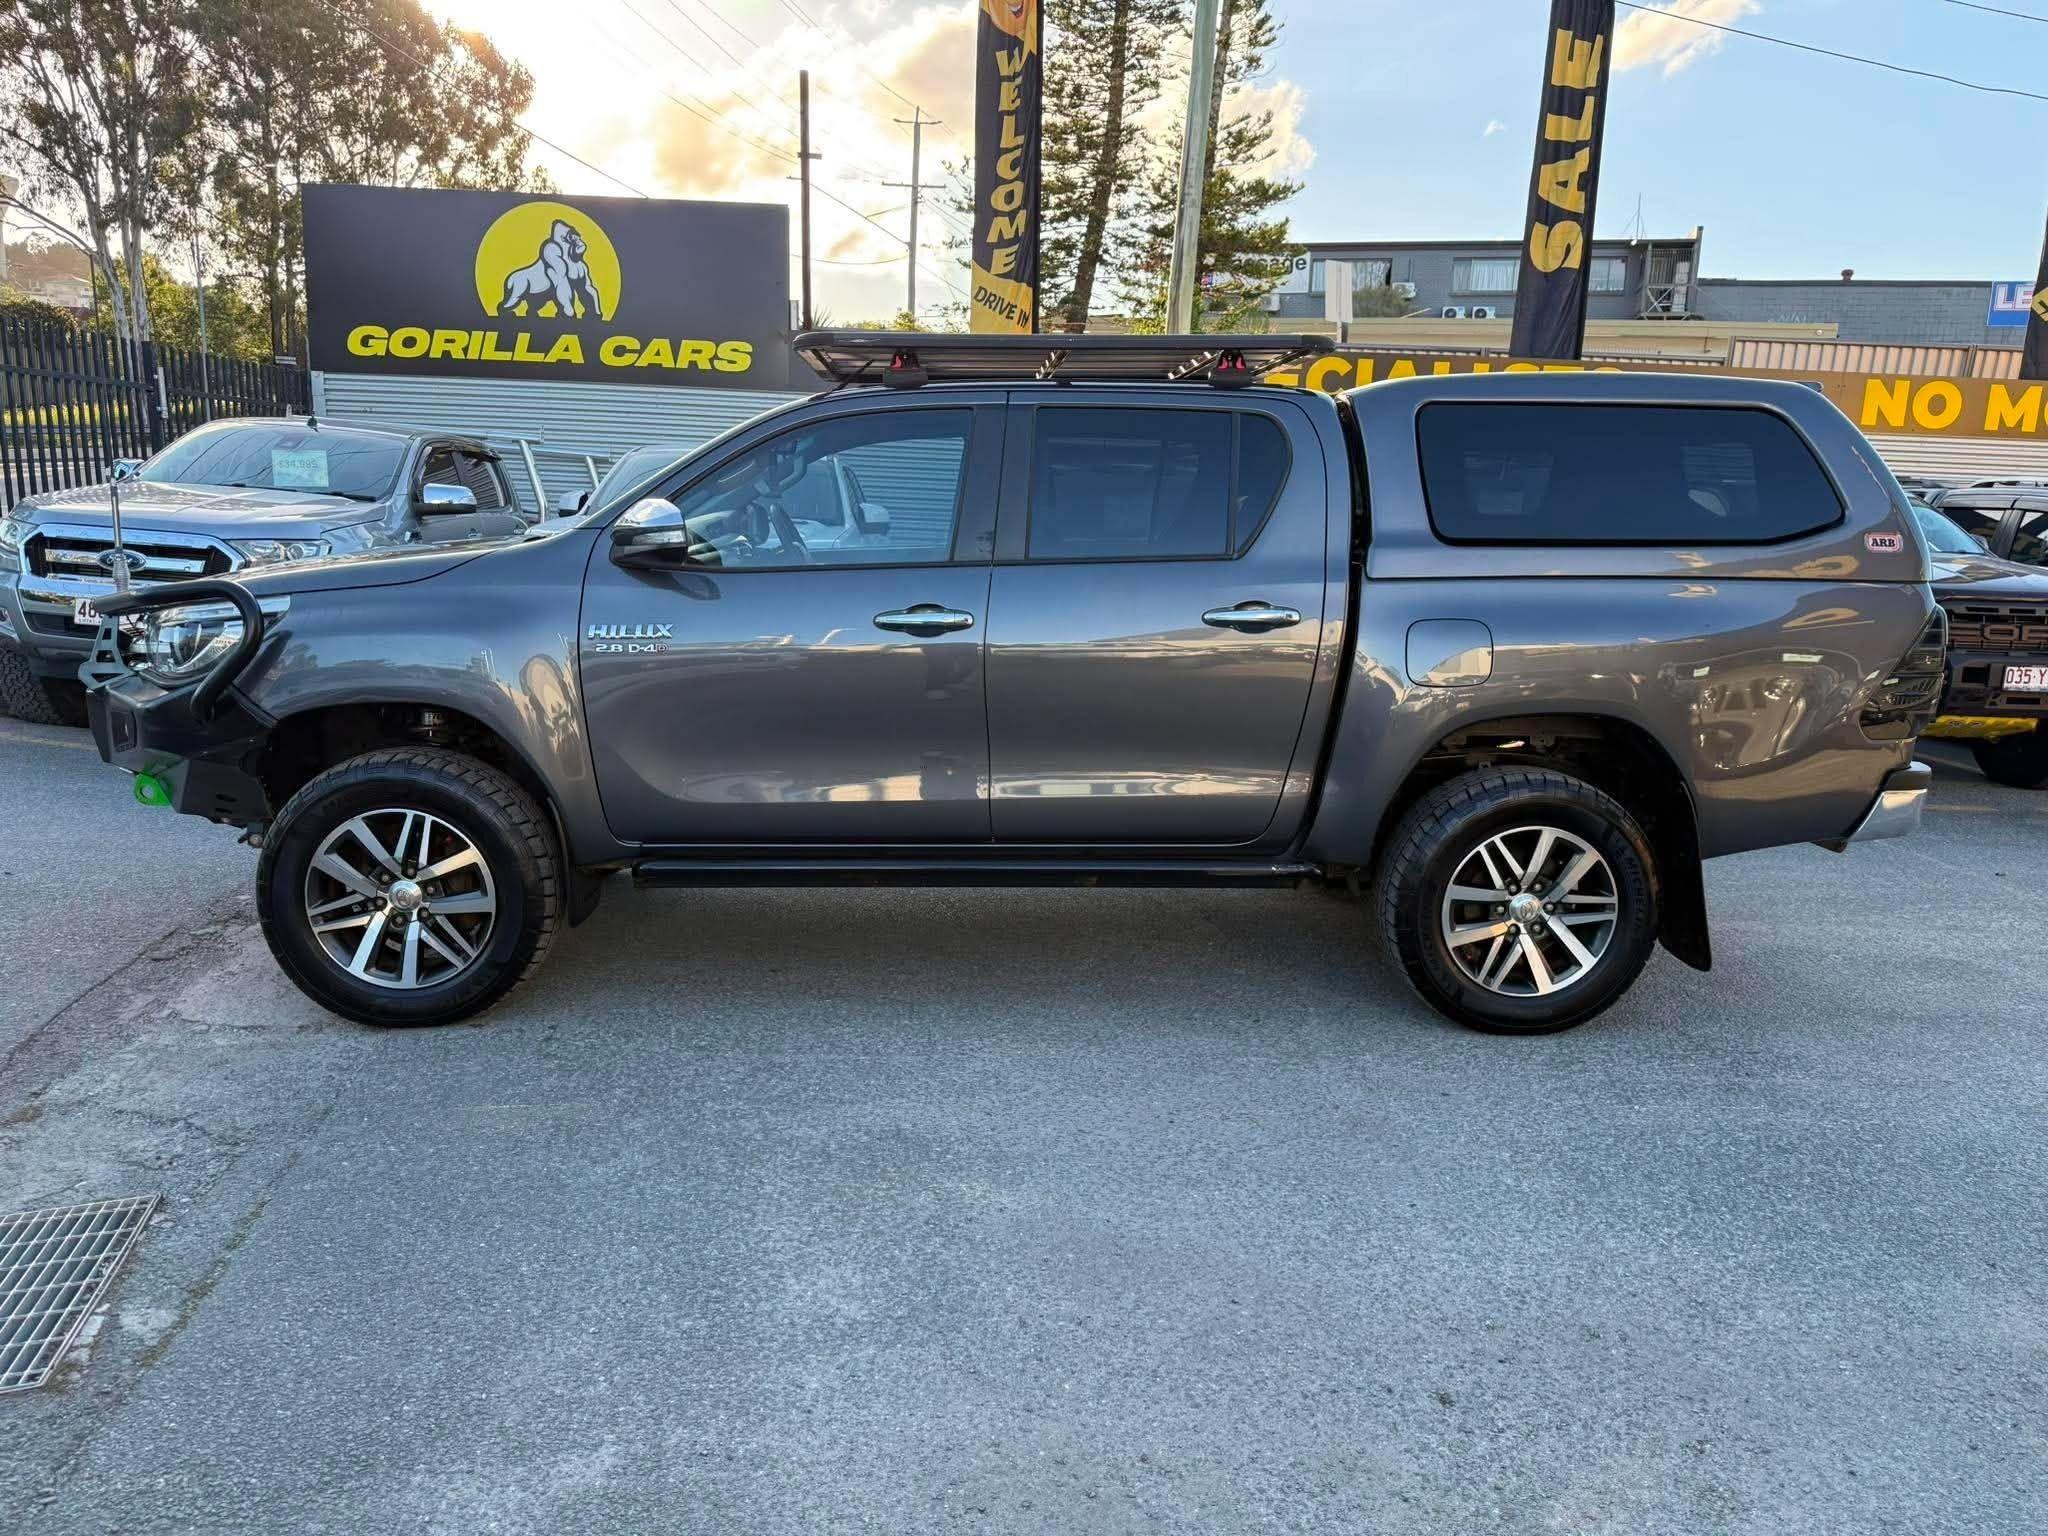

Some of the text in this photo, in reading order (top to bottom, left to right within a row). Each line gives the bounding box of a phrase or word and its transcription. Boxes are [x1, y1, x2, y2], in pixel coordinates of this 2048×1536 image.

[985, 47, 1027, 275] WELCOME
[1529, 28, 1604, 273] SALE
[973, 286, 1031, 329] DRIVE IN
[346, 325, 753, 373] GORILLA CARS
[1860, 378, 2048, 433] NO M
[1871, 538, 1896, 548] ARB
[78, 600, 102, 618] 48
[587, 623, 674, 640] HILUX
[595, 643, 668, 653] 2.8 D-4D
